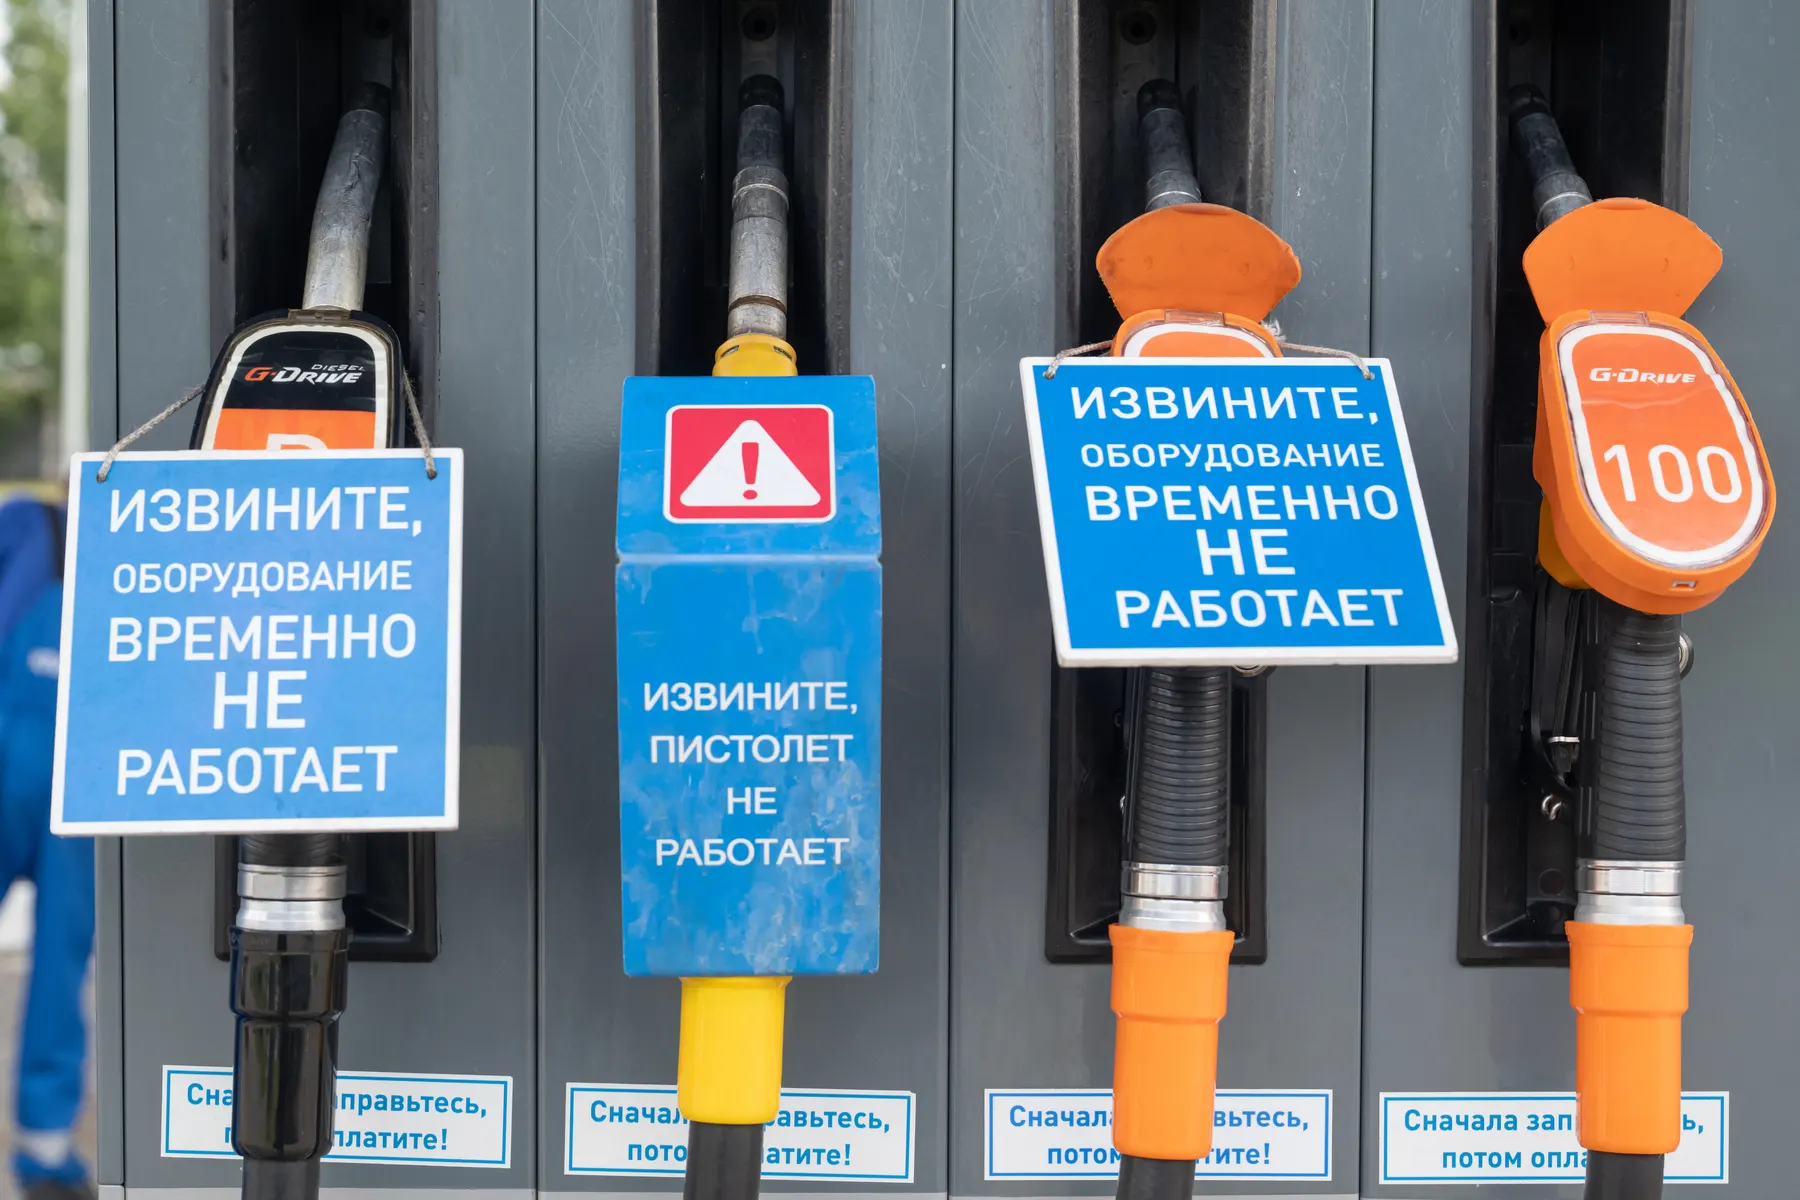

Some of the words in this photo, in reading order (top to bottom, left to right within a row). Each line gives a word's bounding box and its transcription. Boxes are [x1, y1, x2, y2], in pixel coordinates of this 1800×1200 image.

[1071, 386, 1378, 424] ИЗВИНИТЕ,
[1081, 443, 1384, 472] ОБОРУДОВАНИЕ
[1604, 444, 1743, 503] 100
[110, 486, 422, 537] ИЗВИНИТЕ,
[1085, 485, 1398, 521] ВРЕМЕННО
[1196, 528, 1295, 576] НЕ
[113, 560, 413, 598] ОБОРУДОВАНИЕ
[1115, 588, 1403, 628] РАБОТАЕТ
[108, 613, 416, 662] ВРЕМЕННО
[213, 670, 307, 730] НЕ
[644, 681, 857, 714] ИЗВИНИТЕ,
[650, 734, 854, 763] ПИСТОЛЕТ
[117, 745, 399, 796] РАБОТАЕТ
[727, 787, 777, 815] НЕ
[656, 837, 850, 866] РАБОТАЕТ
[335, 1090, 487, 1118] правьтесь,
[1009, 1104, 1112, 1128] Сначал
[1213, 1110, 1309, 1131] вьтесь,
[763, 1109, 890, 1133] авьтесь,
[1404, 1108, 1518, 1132] Сначала
[334, 1127, 448, 1151] платите!
[628, 1143, 688, 1163] пото
[761, 1143, 851, 1166] атите!
[1442, 1151, 1522, 1169] потом
